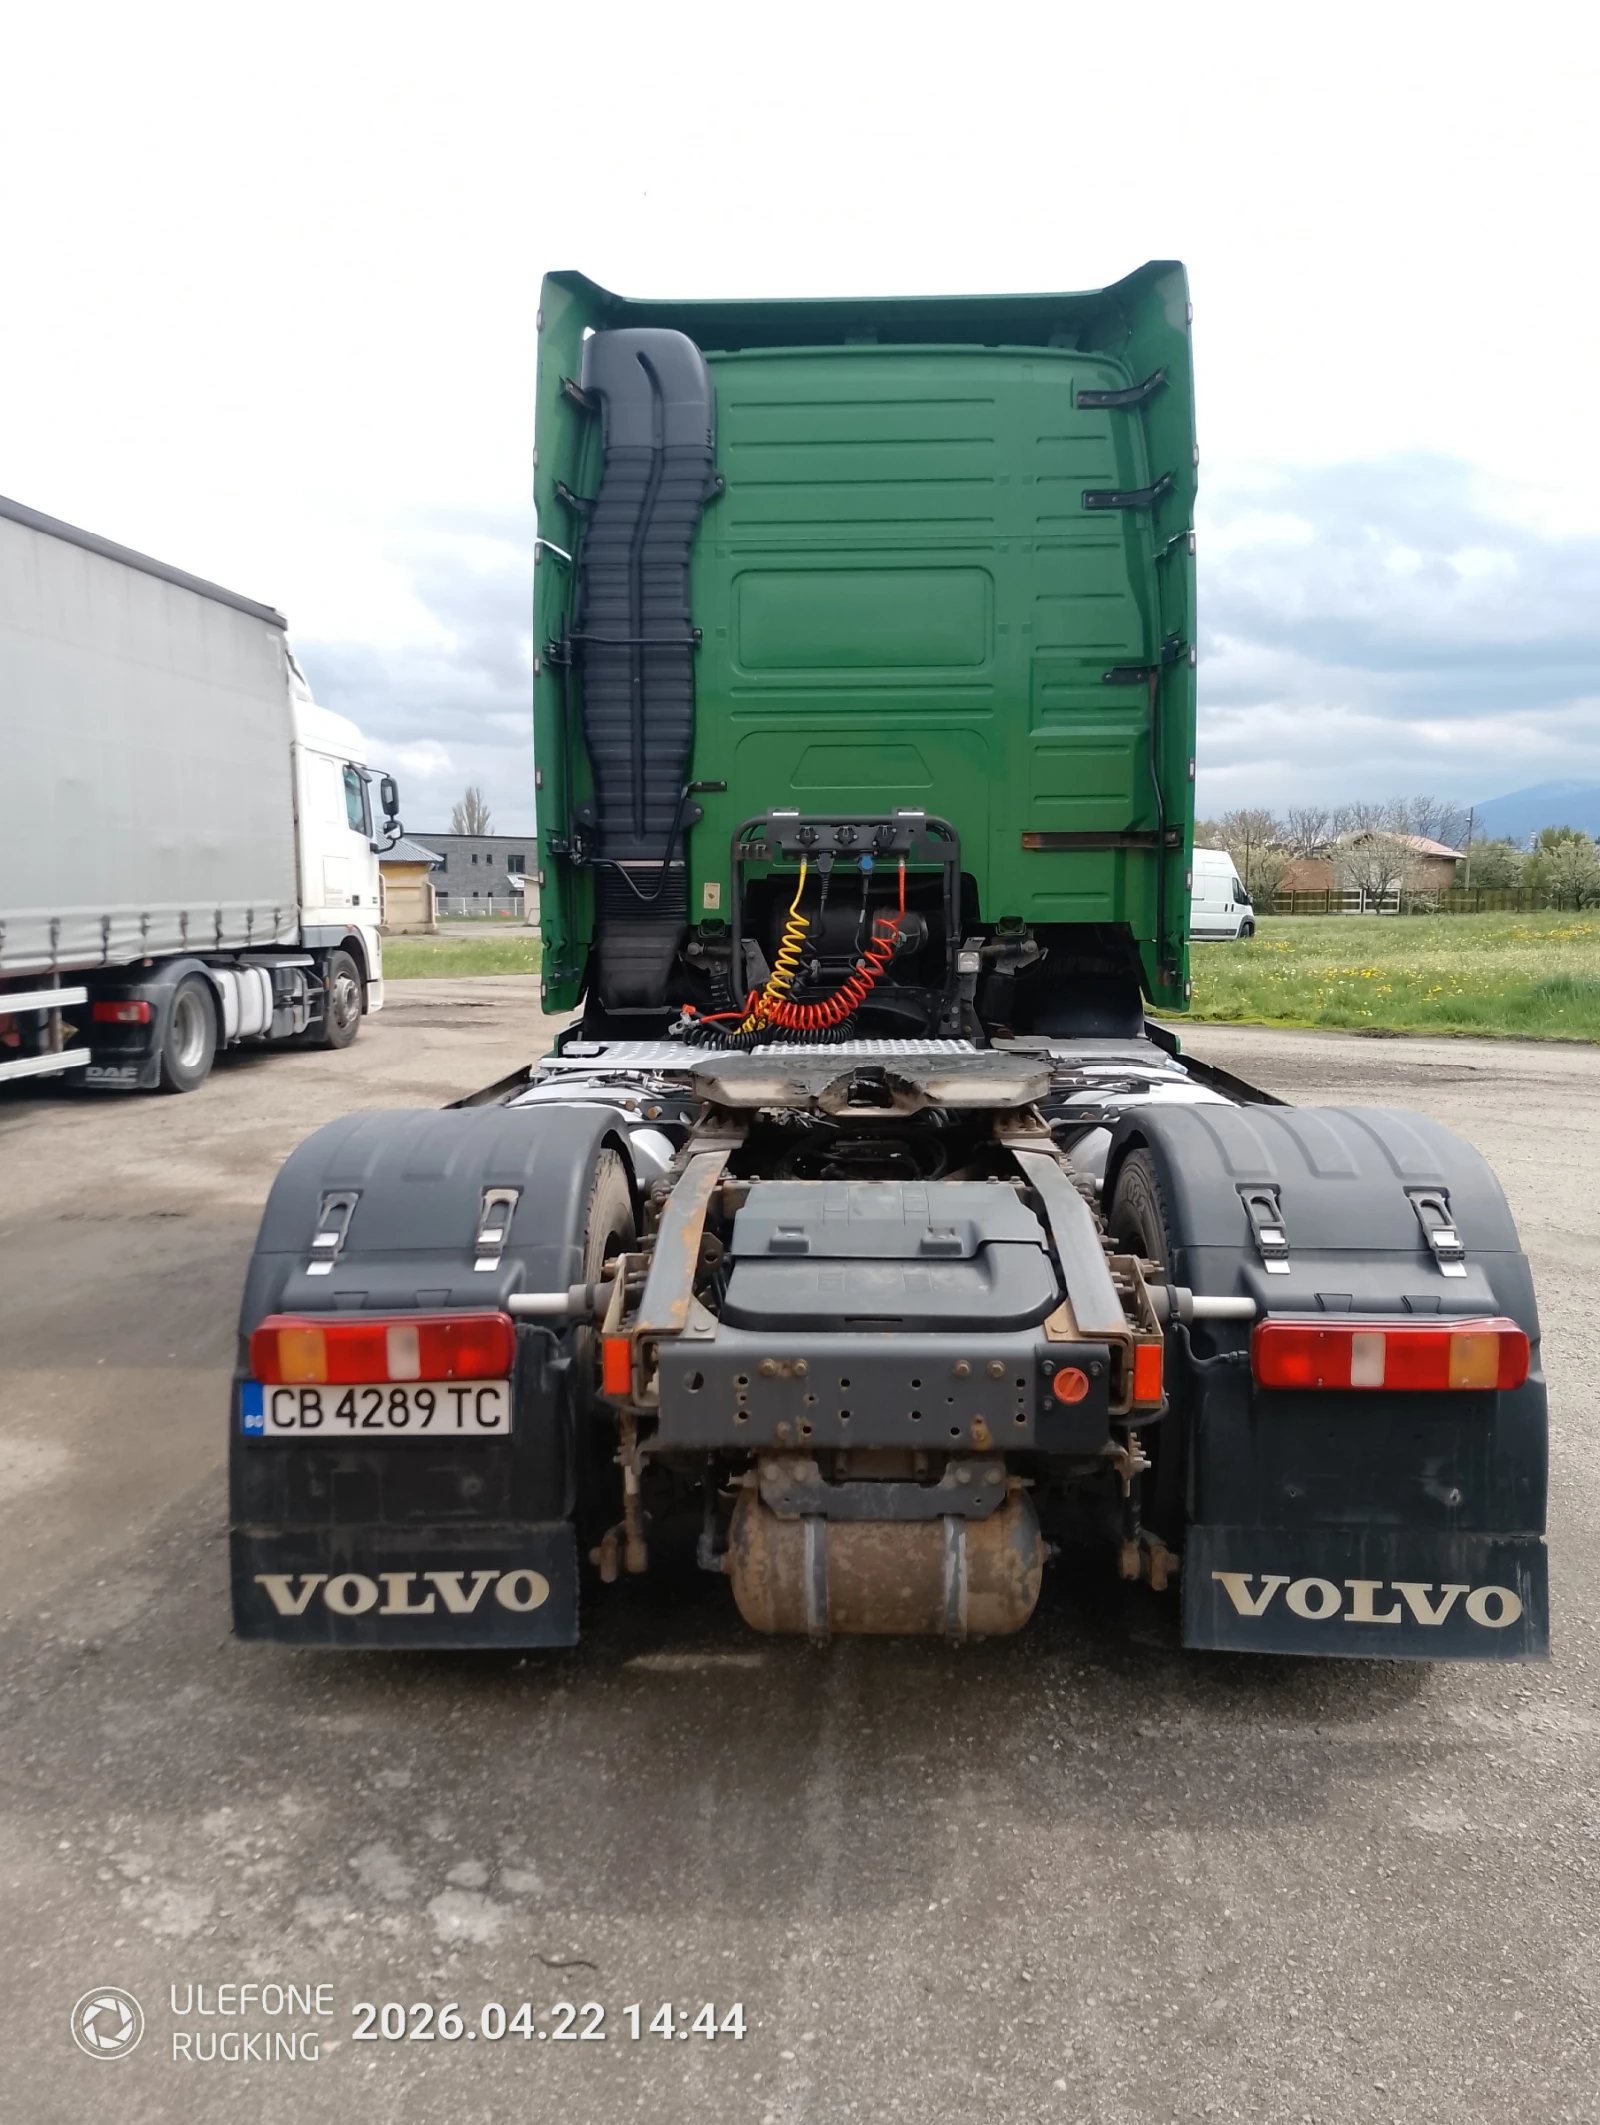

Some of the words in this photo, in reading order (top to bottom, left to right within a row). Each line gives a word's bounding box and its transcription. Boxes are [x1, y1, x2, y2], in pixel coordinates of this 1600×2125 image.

[85, 1066, 138, 1078] DAF
[271, 1387, 325, 1429] CB
[335, 1387, 437, 1429] 4289
[447, 1386, 502, 1429] TC
[254, 1569, 551, 1616] VOLVO
[1211, 1571, 1524, 1629] VOLVO
